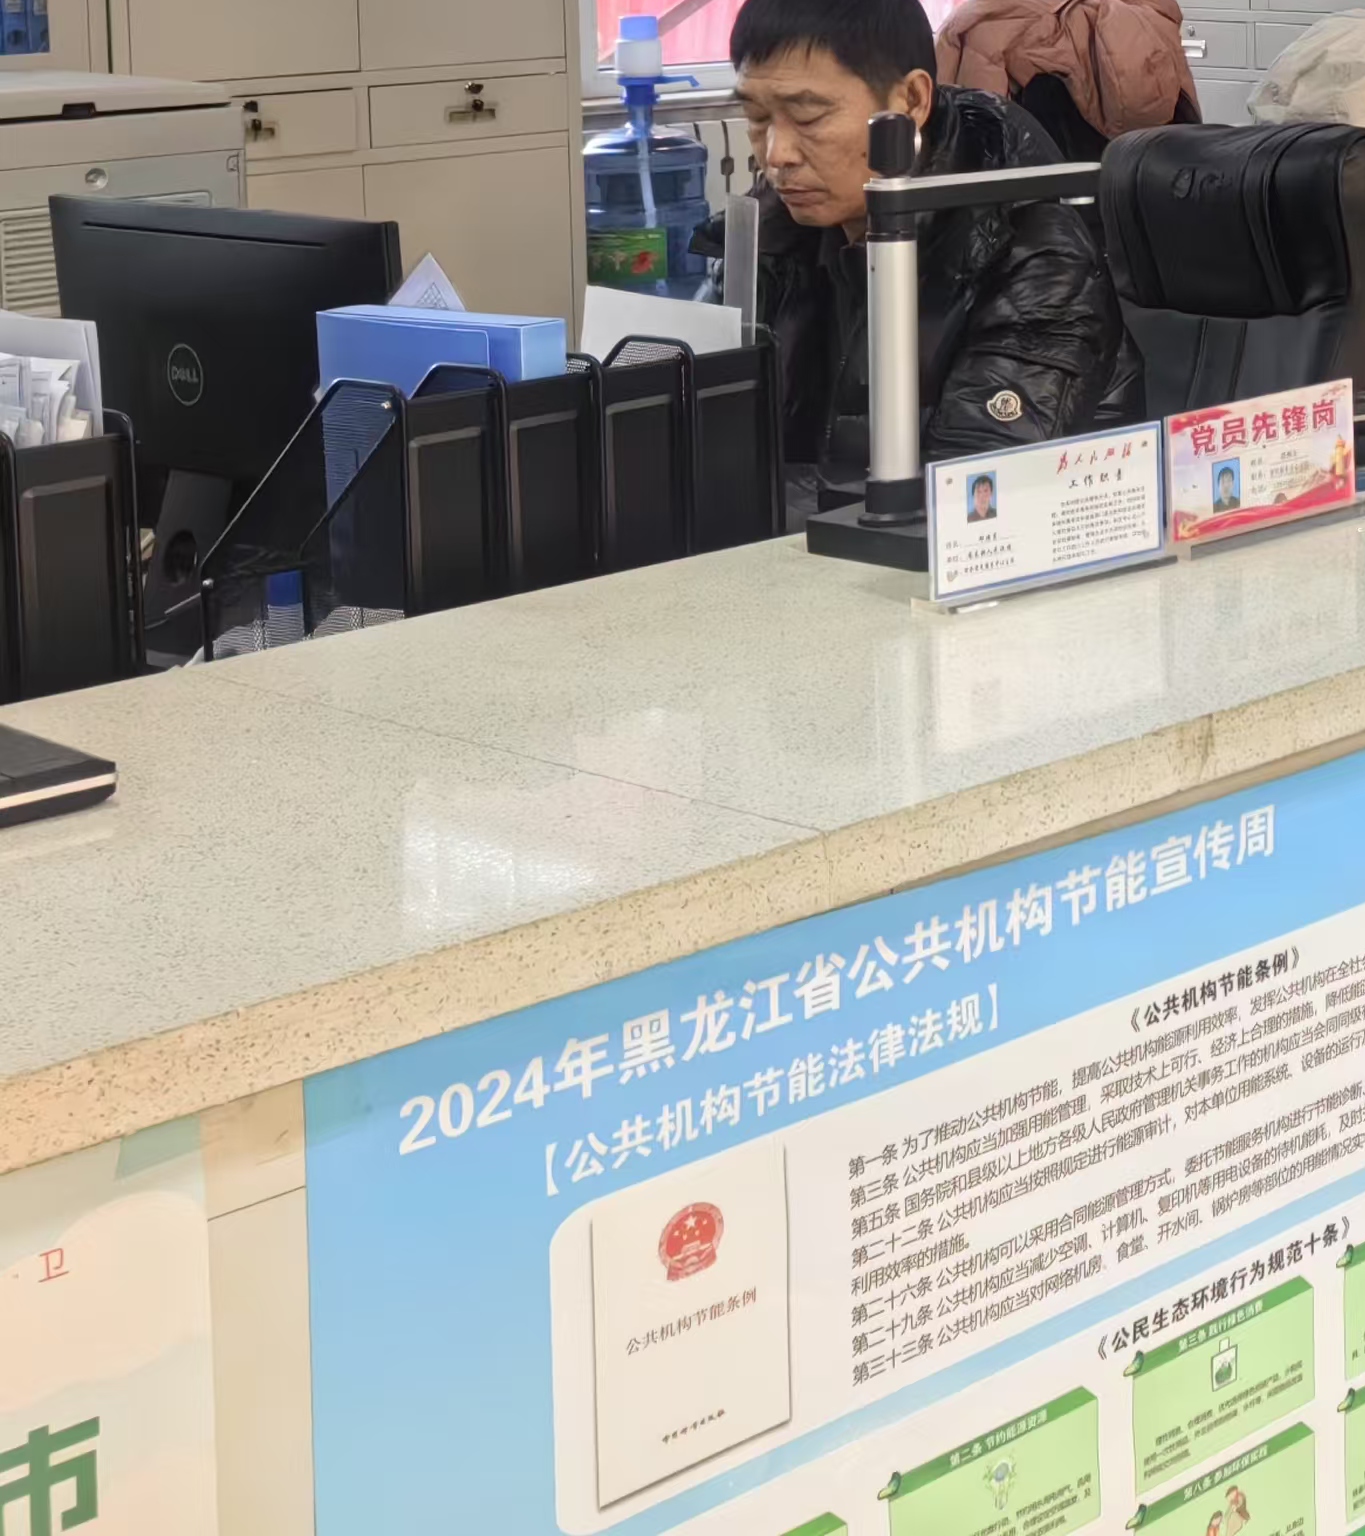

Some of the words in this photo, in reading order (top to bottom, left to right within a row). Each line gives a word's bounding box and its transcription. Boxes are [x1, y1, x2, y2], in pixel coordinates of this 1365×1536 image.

[171, 365, 199, 383] DELL
[1055, 441, 1133, 474] 为人民服务
[1190, 399, 1337, 457] 党员先锋岗
[1068, 468, 1124, 490] 工作职责
[396, 801, 1276, 1167] 2024年黑龙江省公共机构节能宣传周
[1130, 943, 1300, 1036] 《公共机构节能条例》
[543, 981, 999, 1202] 【公共机构节能法律法规】
[848, 1139, 898, 1182] 第一条
[848, 1169, 899, 1212] 第三条
[849, 1199, 900, 1243] 第五条
[849, 1214, 934, 1273] 第二十二条
[38, 1247, 70, 1283] 卫
[850, 1225, 972, 1303] 利用效率的措施。
[1097, 1209, 1354, 1366] 《公民生态环境行为规范十条》
[625, 1283, 758, 1359] 公共机构节能条例
[850, 1271, 934, 1331] 第二十六条
[850, 1300, 934, 1361] 第二十九条
[851, 1328, 935, 1390] 第三十三条
[950, 1438, 982, 1473] 第二条
